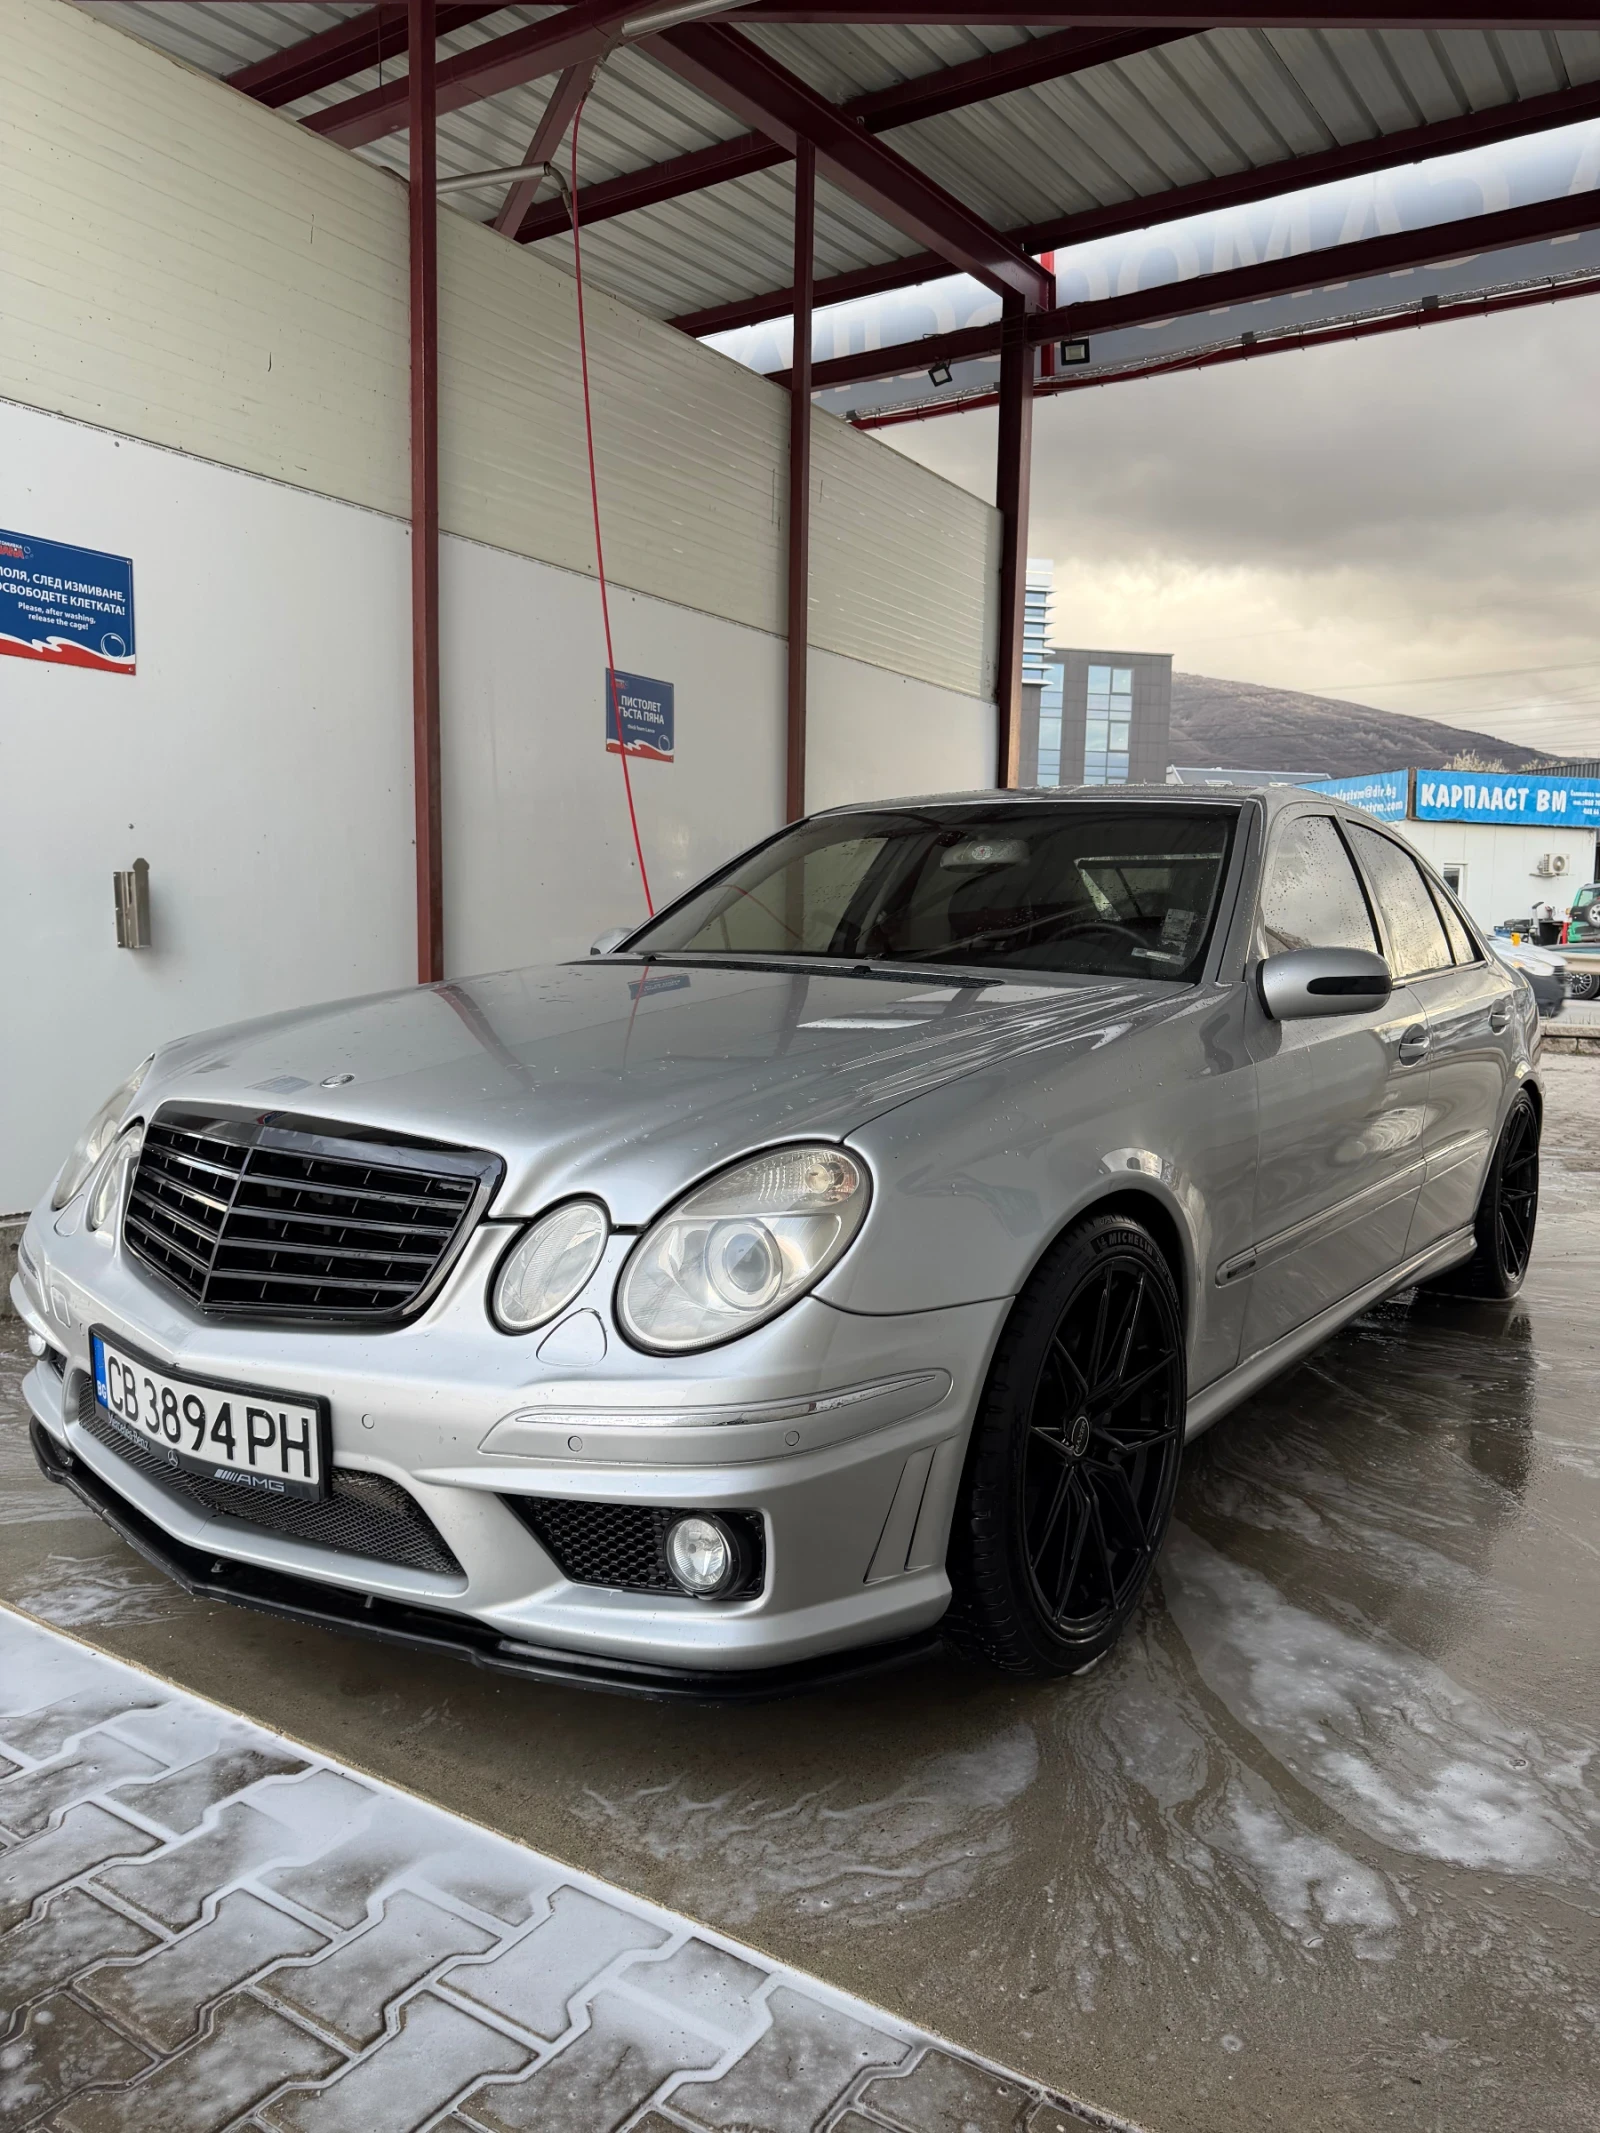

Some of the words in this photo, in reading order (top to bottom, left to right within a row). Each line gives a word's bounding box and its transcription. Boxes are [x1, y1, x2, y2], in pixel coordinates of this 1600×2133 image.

[32, 573, 62, 590] СЛЕД
[64, 579, 126, 603] ИЗМИВАНЕ,
[18, 601, 44, 614] Please,
[45, 607, 63, 617] after
[64, 612, 96, 624] washing,
[70, 596, 125, 616] КЛЕТКАТА!
[28, 613, 55, 624] release
[56, 618, 68, 627] the
[69, 620, 89, 631] cage!
[621, 695, 662, 713] ПИСТОЛЕТ
[643, 711, 665, 725] ПЯНА
[1421, 783, 1529, 811] КАРПЛАСТ
[1536, 789, 1567, 813] ВМ
[1108, 1232, 1154, 1256] MICHELIN
[97, 1380, 107, 1400] BG
[107, 1411, 150, 1451] Mercedes-Benz
[236, 1474, 285, 1493] AMG
